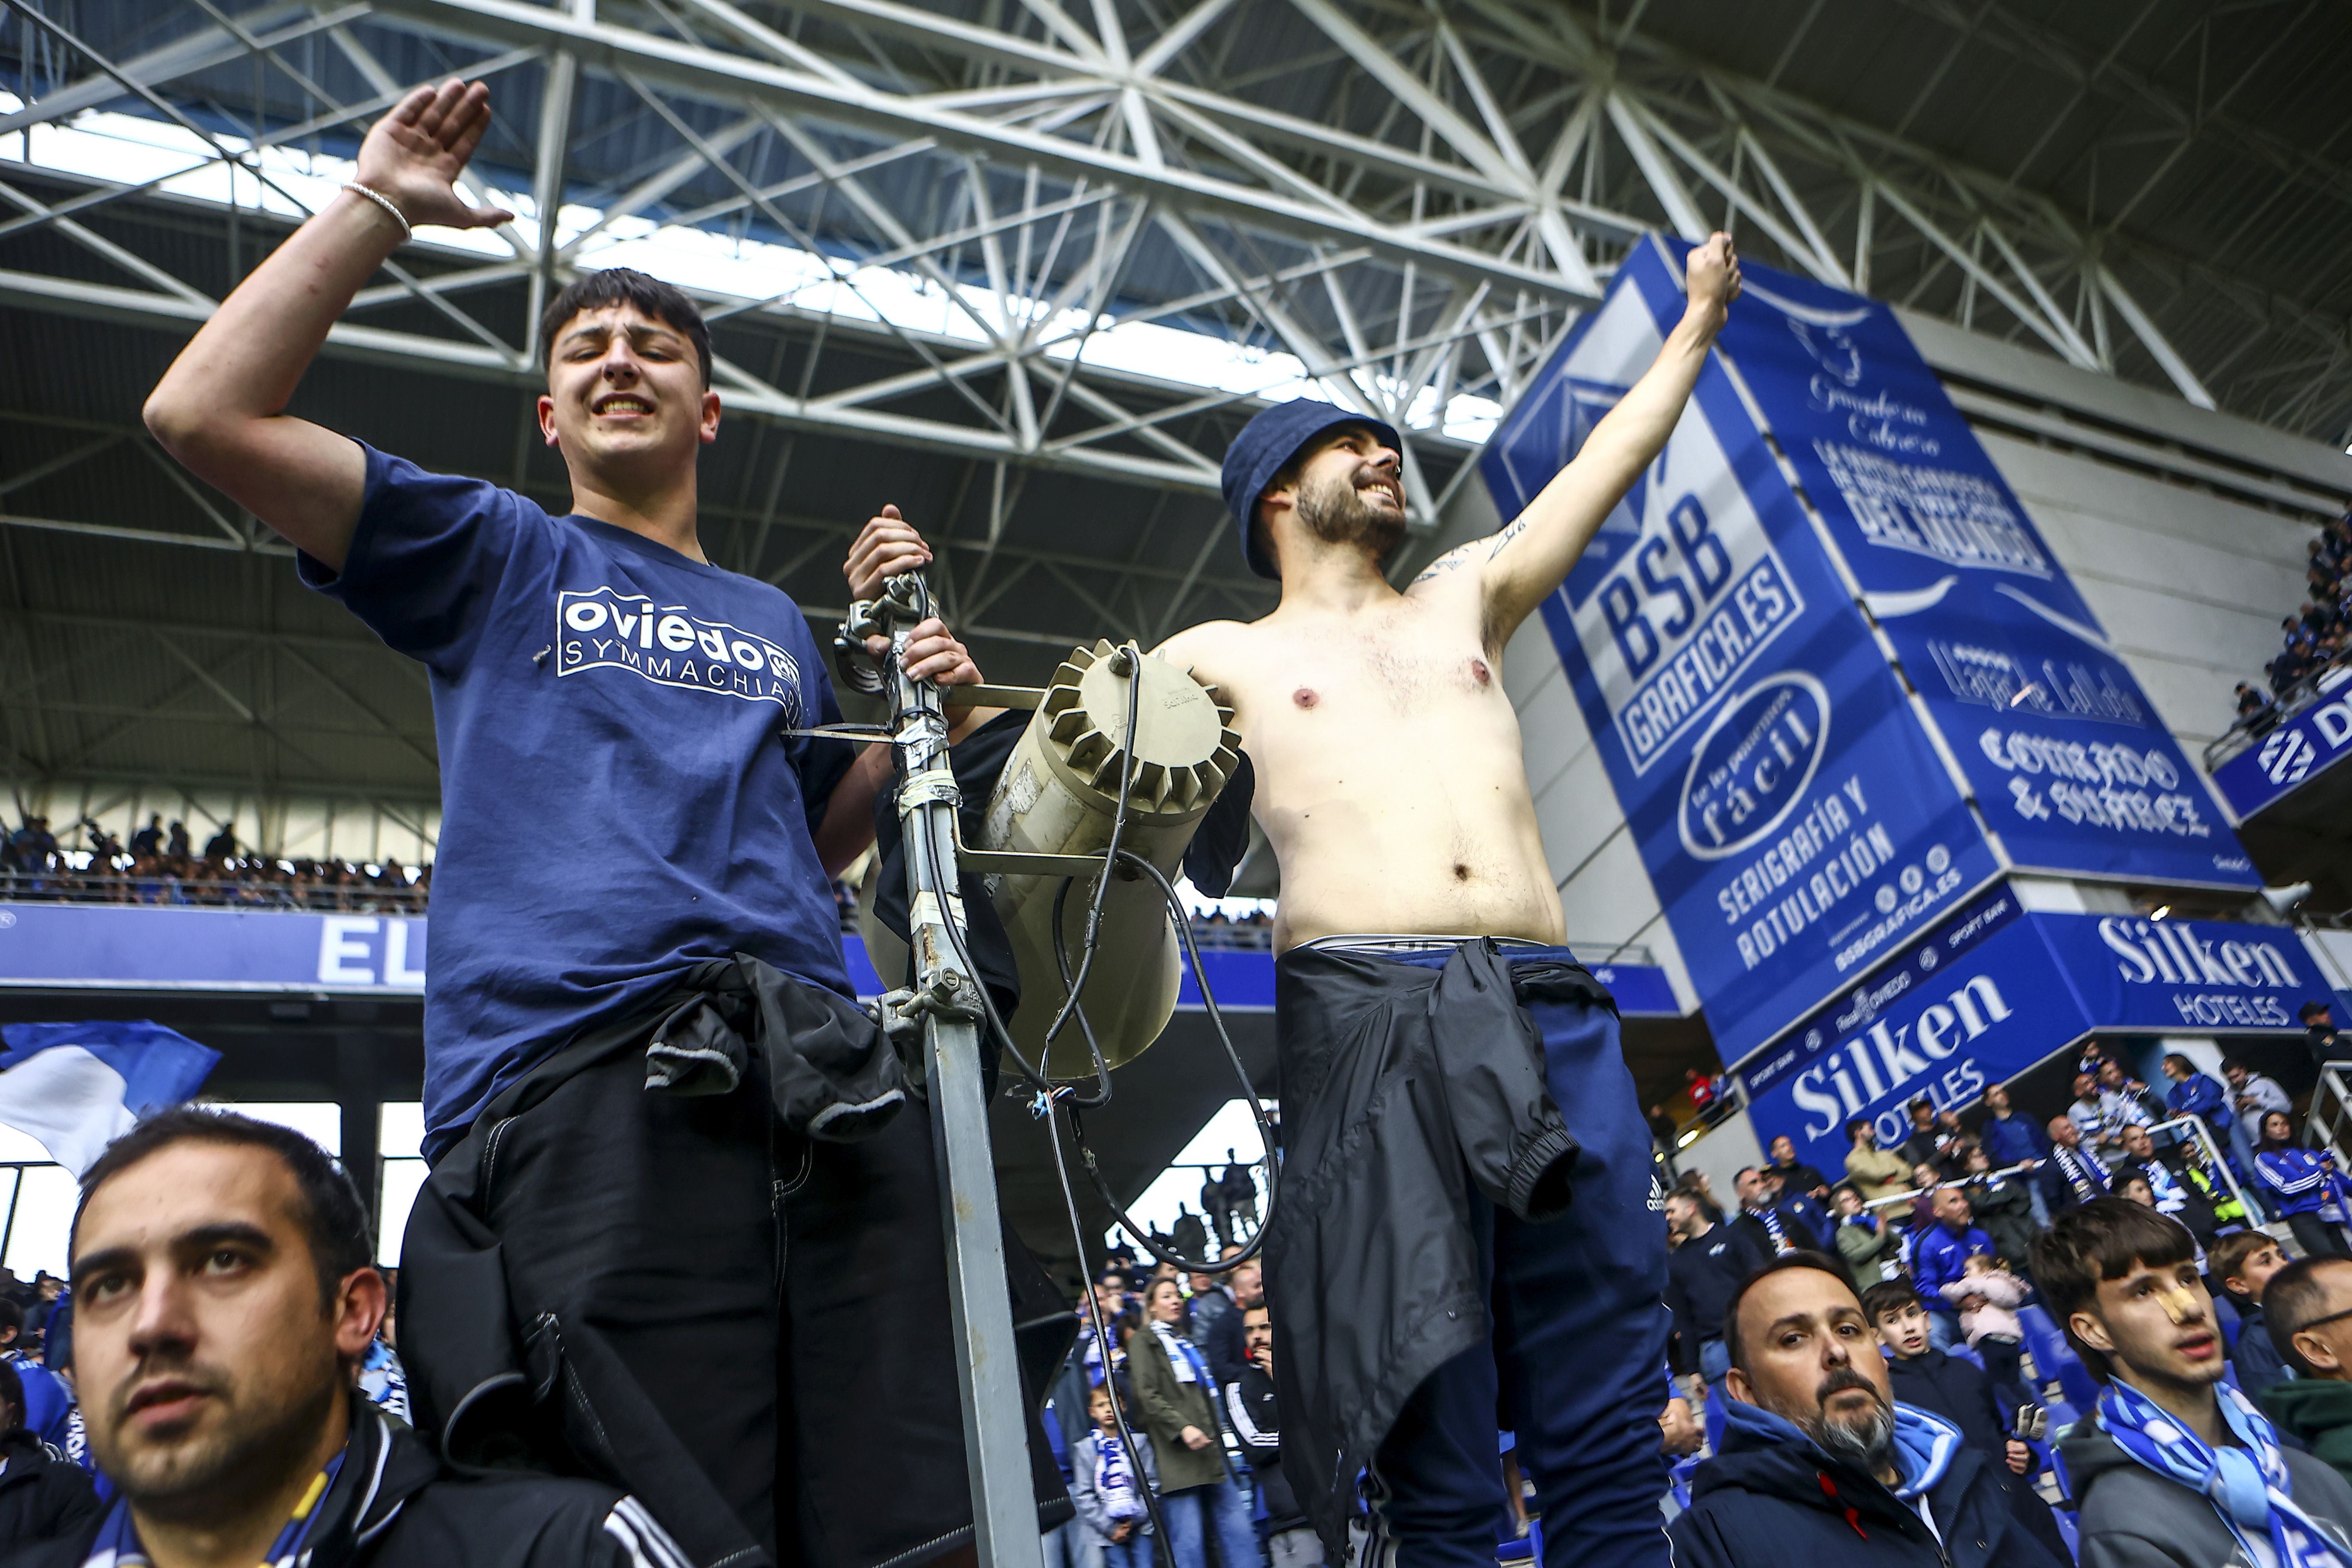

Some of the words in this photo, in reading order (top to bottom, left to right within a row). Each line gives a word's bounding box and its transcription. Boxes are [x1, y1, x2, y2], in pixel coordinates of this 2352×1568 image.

[565, 600, 765, 671] oviedo
[1597, 492, 1734, 683] BSB
[1625, 565, 1785, 756] GRAFICA.ES
[1703, 710, 1813, 846] fácil
[1718, 793, 1851, 926] SERIGRAFÍA
[1843, 774, 1868, 816] Y
[1736, 821, 1896, 971] ROTULACIÓN
[2098, 916, 2303, 989] Silken
[1792, 974, 2014, 1143] Silken
[2172, 992, 2291, 1027] HOTELES
